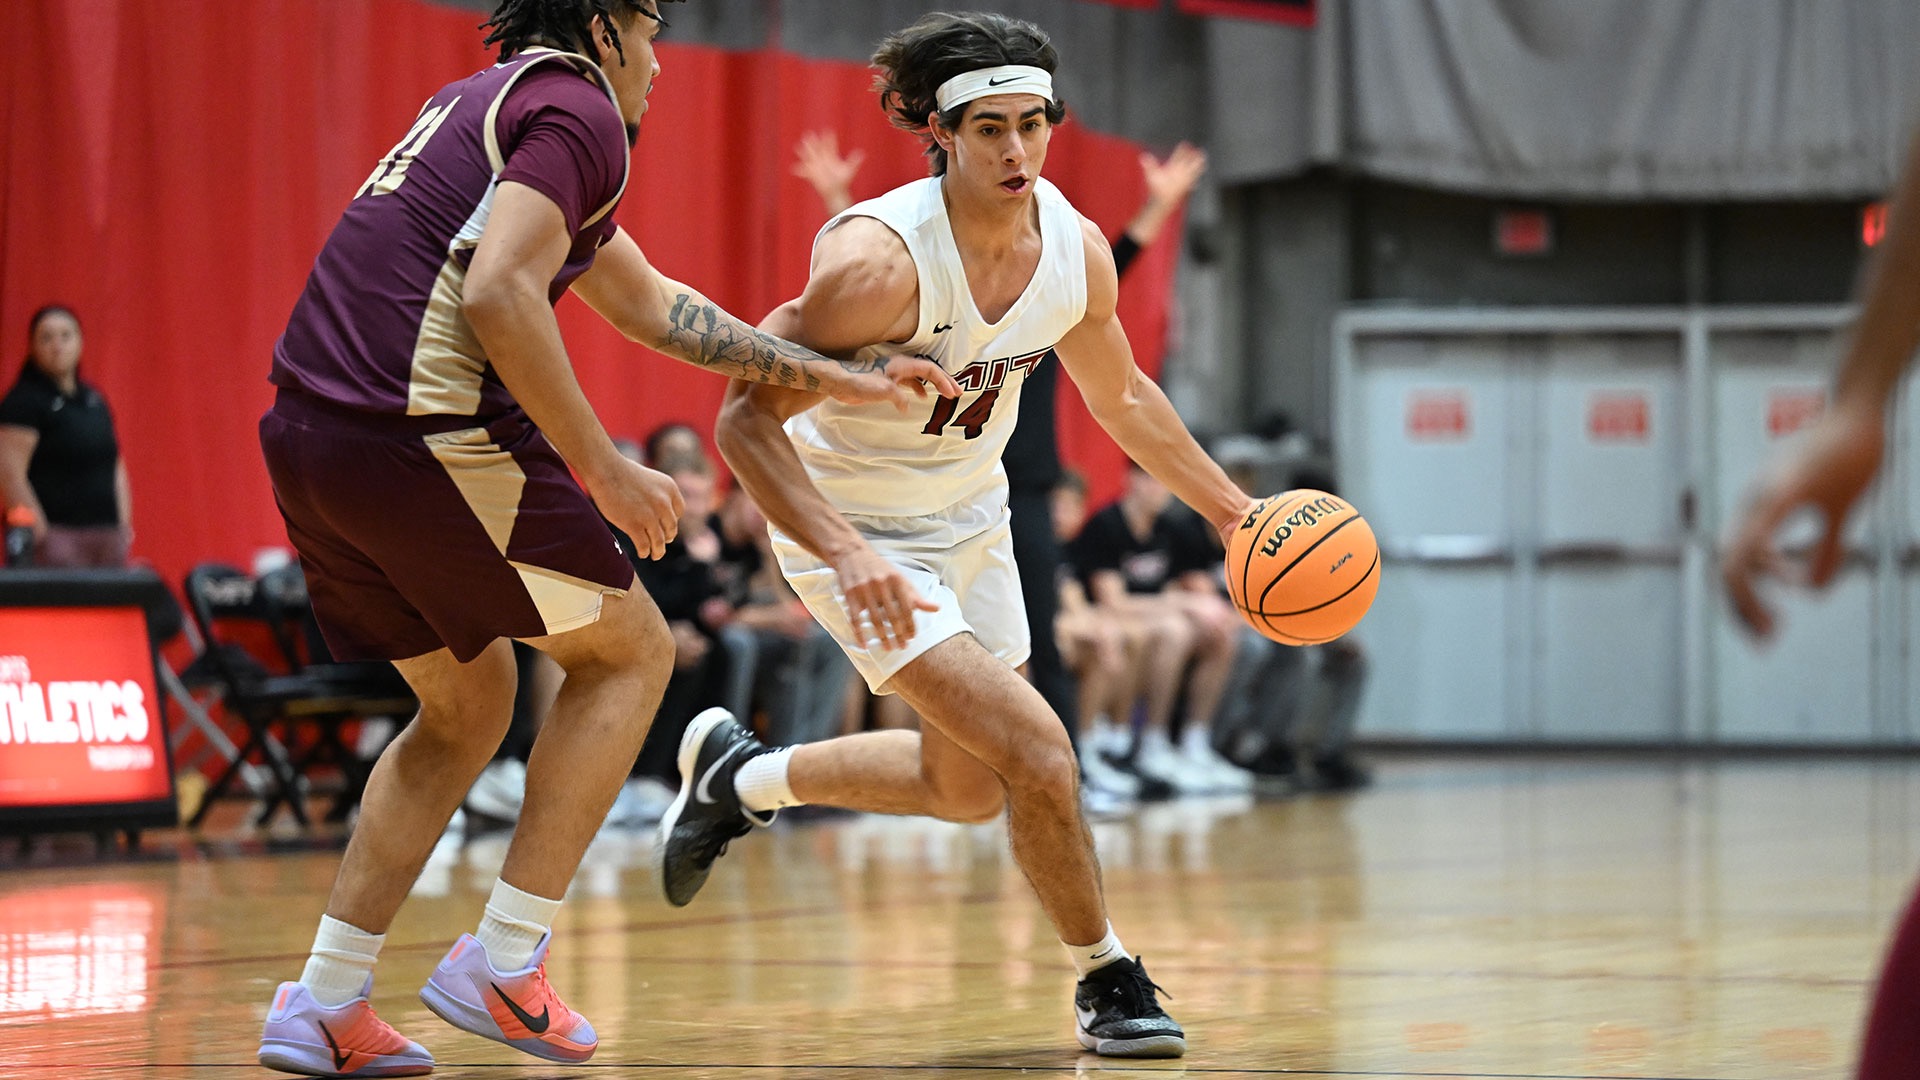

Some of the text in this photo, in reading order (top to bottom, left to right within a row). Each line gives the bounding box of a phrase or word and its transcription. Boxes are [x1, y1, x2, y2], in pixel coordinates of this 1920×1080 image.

[920, 386, 1001, 440] 14
[1240, 491, 1286, 531] CAA
[1260, 496, 1345, 558] Wilson
[0, 679, 149, 744] THLETICS
